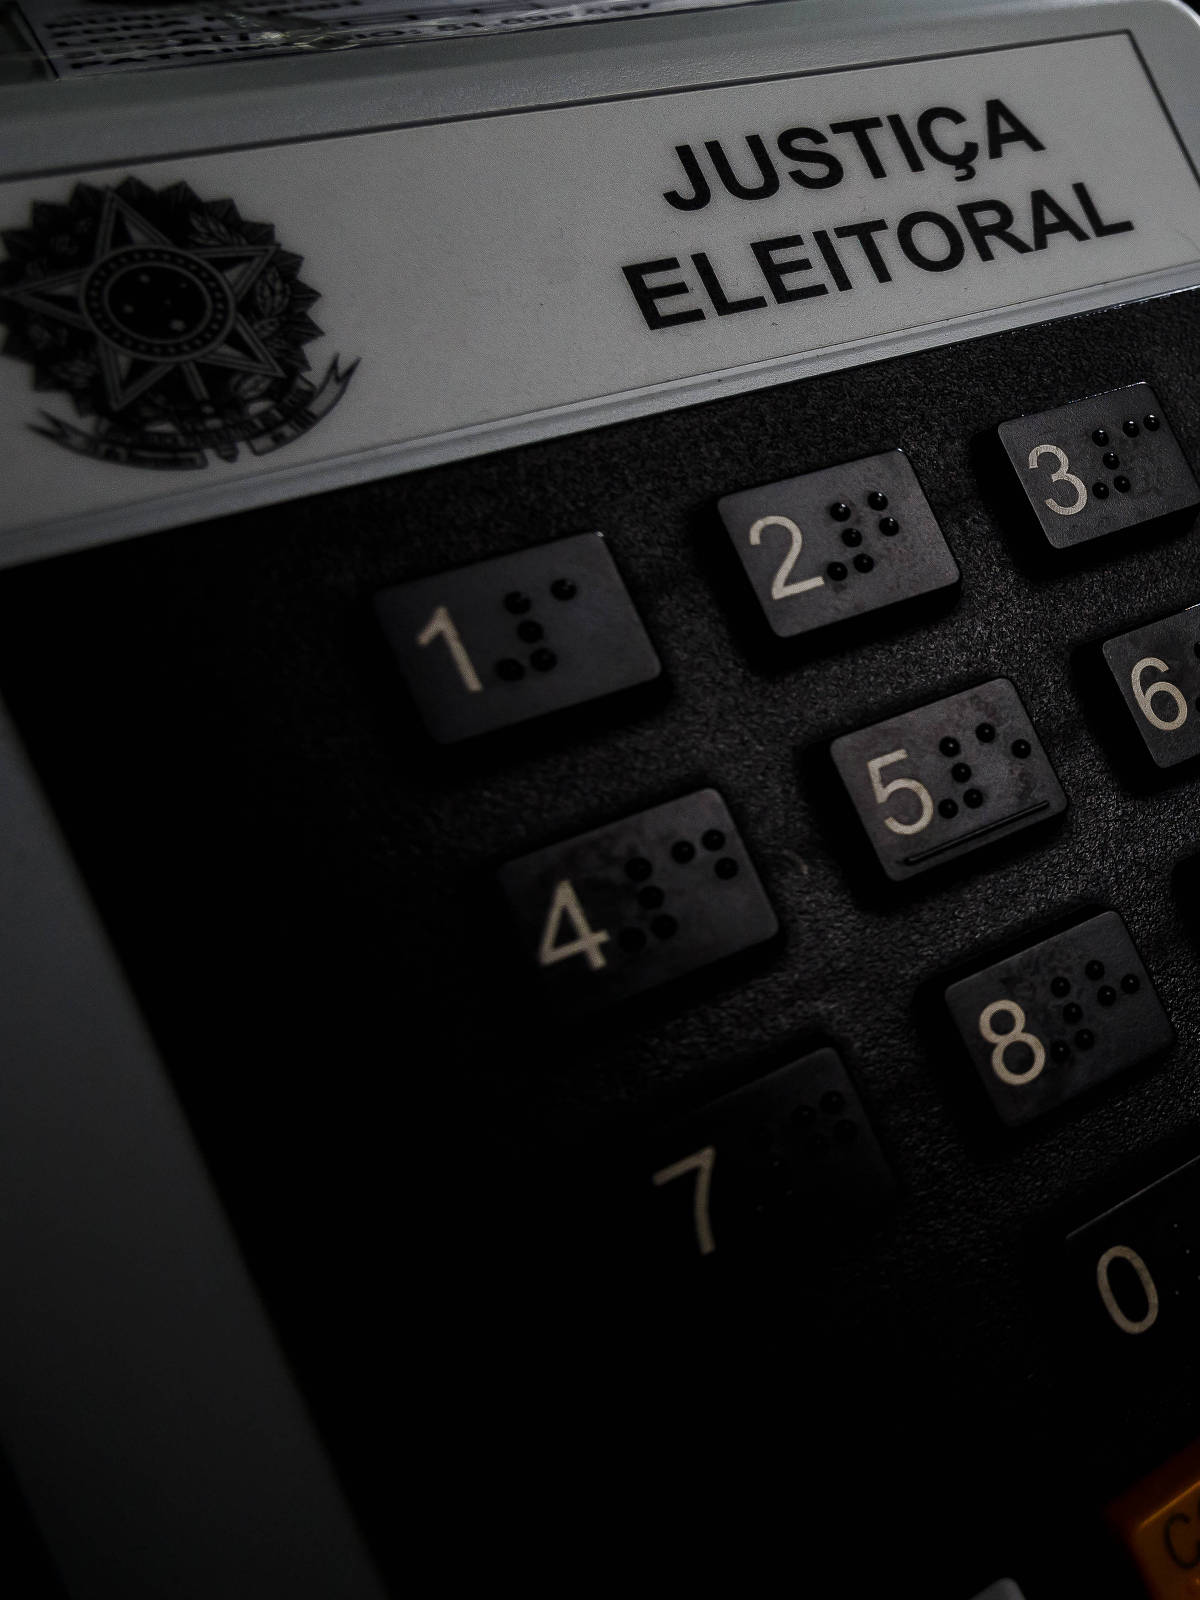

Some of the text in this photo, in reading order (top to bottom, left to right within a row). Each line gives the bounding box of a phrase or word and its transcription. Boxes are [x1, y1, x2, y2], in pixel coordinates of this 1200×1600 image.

[663, 99, 1046, 212] JUSTIÇA
[621, 182, 1134, 330] ELEITORAL
[1027, 443, 1089, 517] 3
[748, 514, 826, 601] 2
[417, 605, 484, 693] 1
[1129, 655, 1189, 732] 6
[866, 747, 935, 836] 5
[537, 878, 611, 971] 4
[978, 998, 1047, 1087] 8
[652, 1145, 717, 1256] 7
[1095, 1244, 1160, 1336] 0
